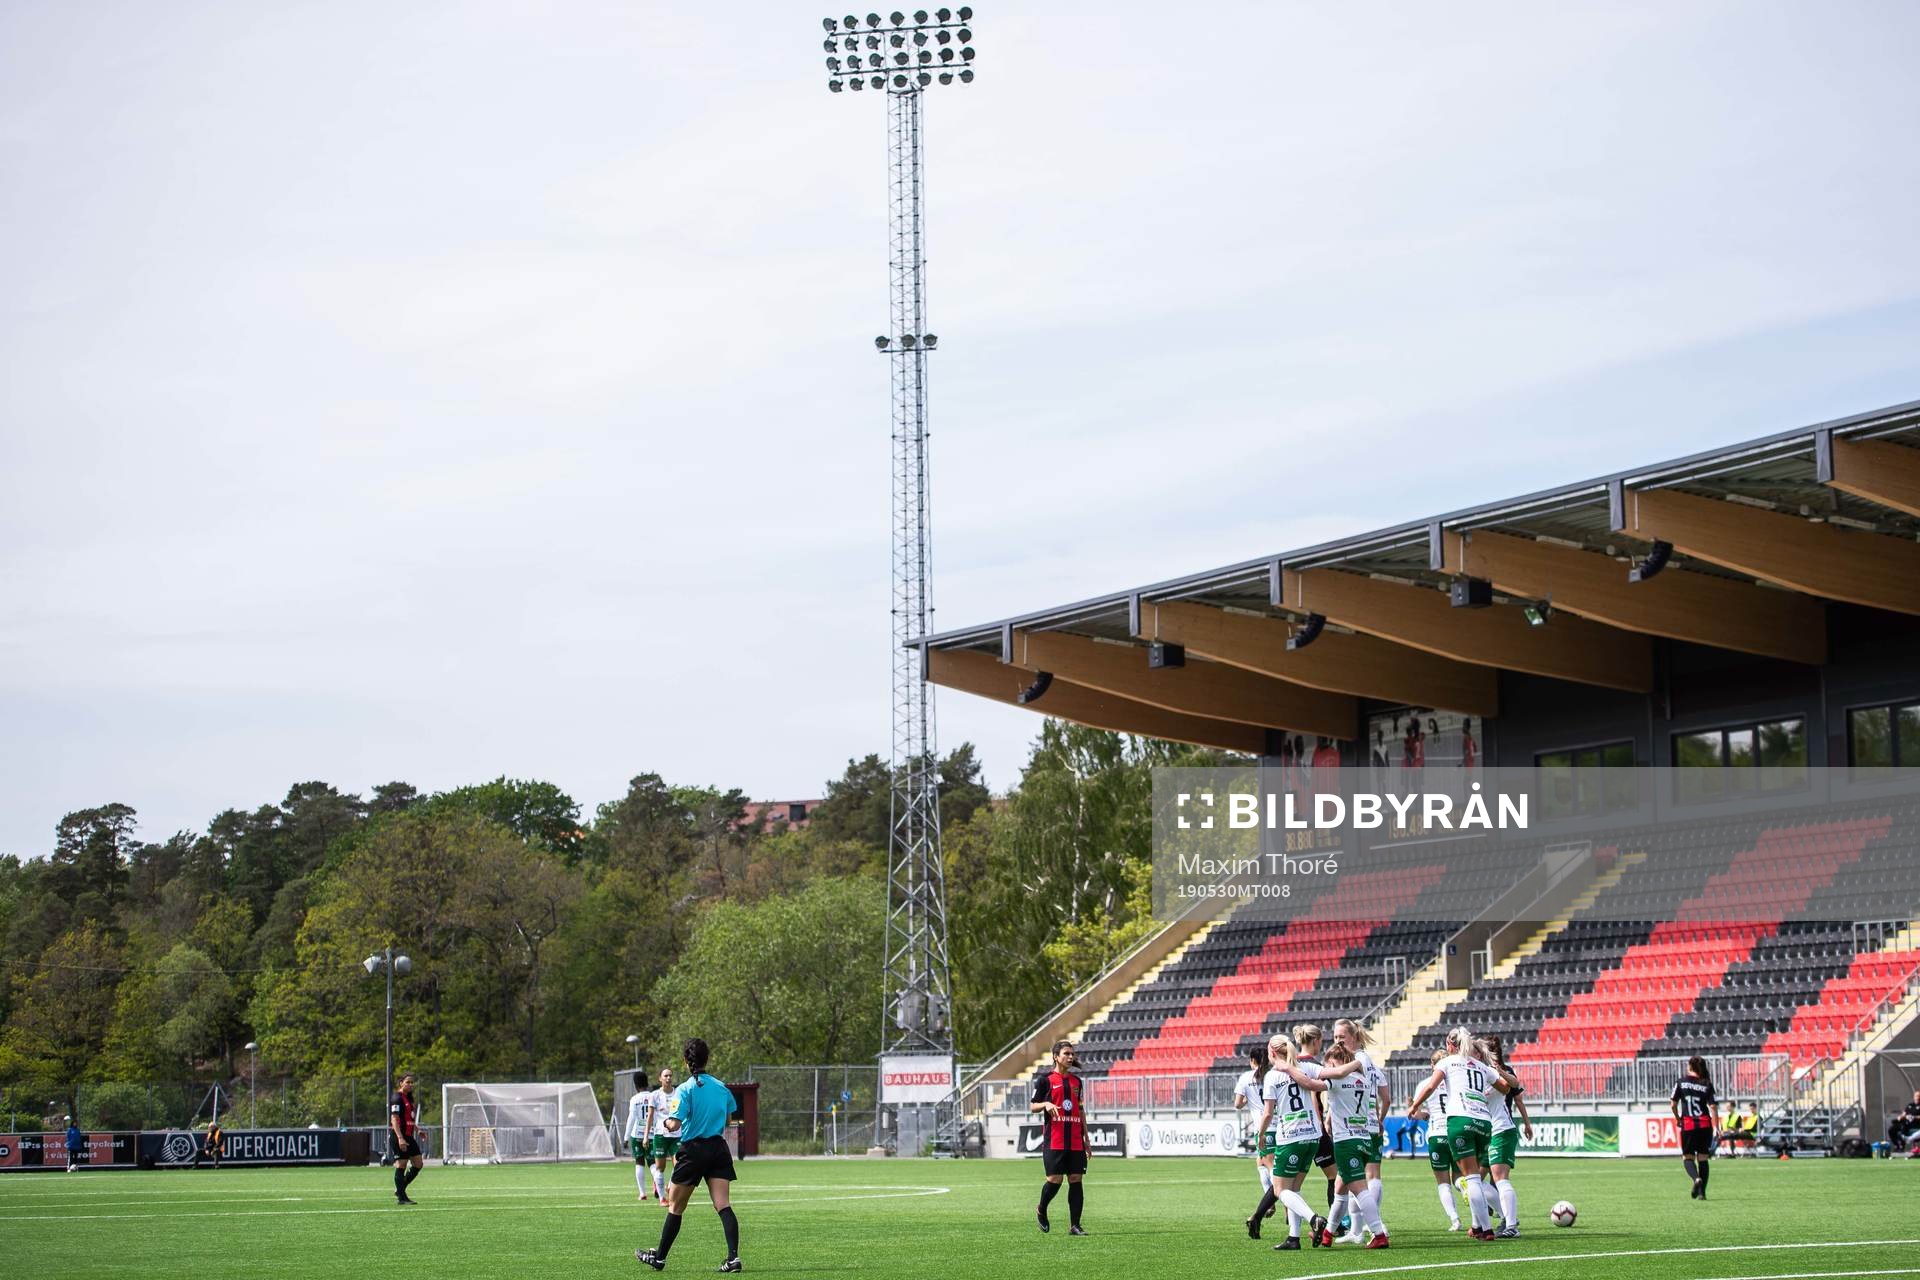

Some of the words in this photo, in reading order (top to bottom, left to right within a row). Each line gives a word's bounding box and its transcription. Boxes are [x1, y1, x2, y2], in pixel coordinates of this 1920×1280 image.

[884, 1073, 950, 1085] BAUHAUS
[1467, 1069, 1483, 1093] 10
[1288, 1083, 1304, 1112] 8
[1354, 1090, 1364, 1114] 7
[1685, 1095, 1703, 1117] 15
[43, 1140, 61, 1148] och
[83, 1140, 124, 1149] tryckeri
[222, 1135, 319, 1158] UPERCOACH
[1087, 1128, 1118, 1147] adium
[1158, 1129, 1217, 1148] Volkswagen
